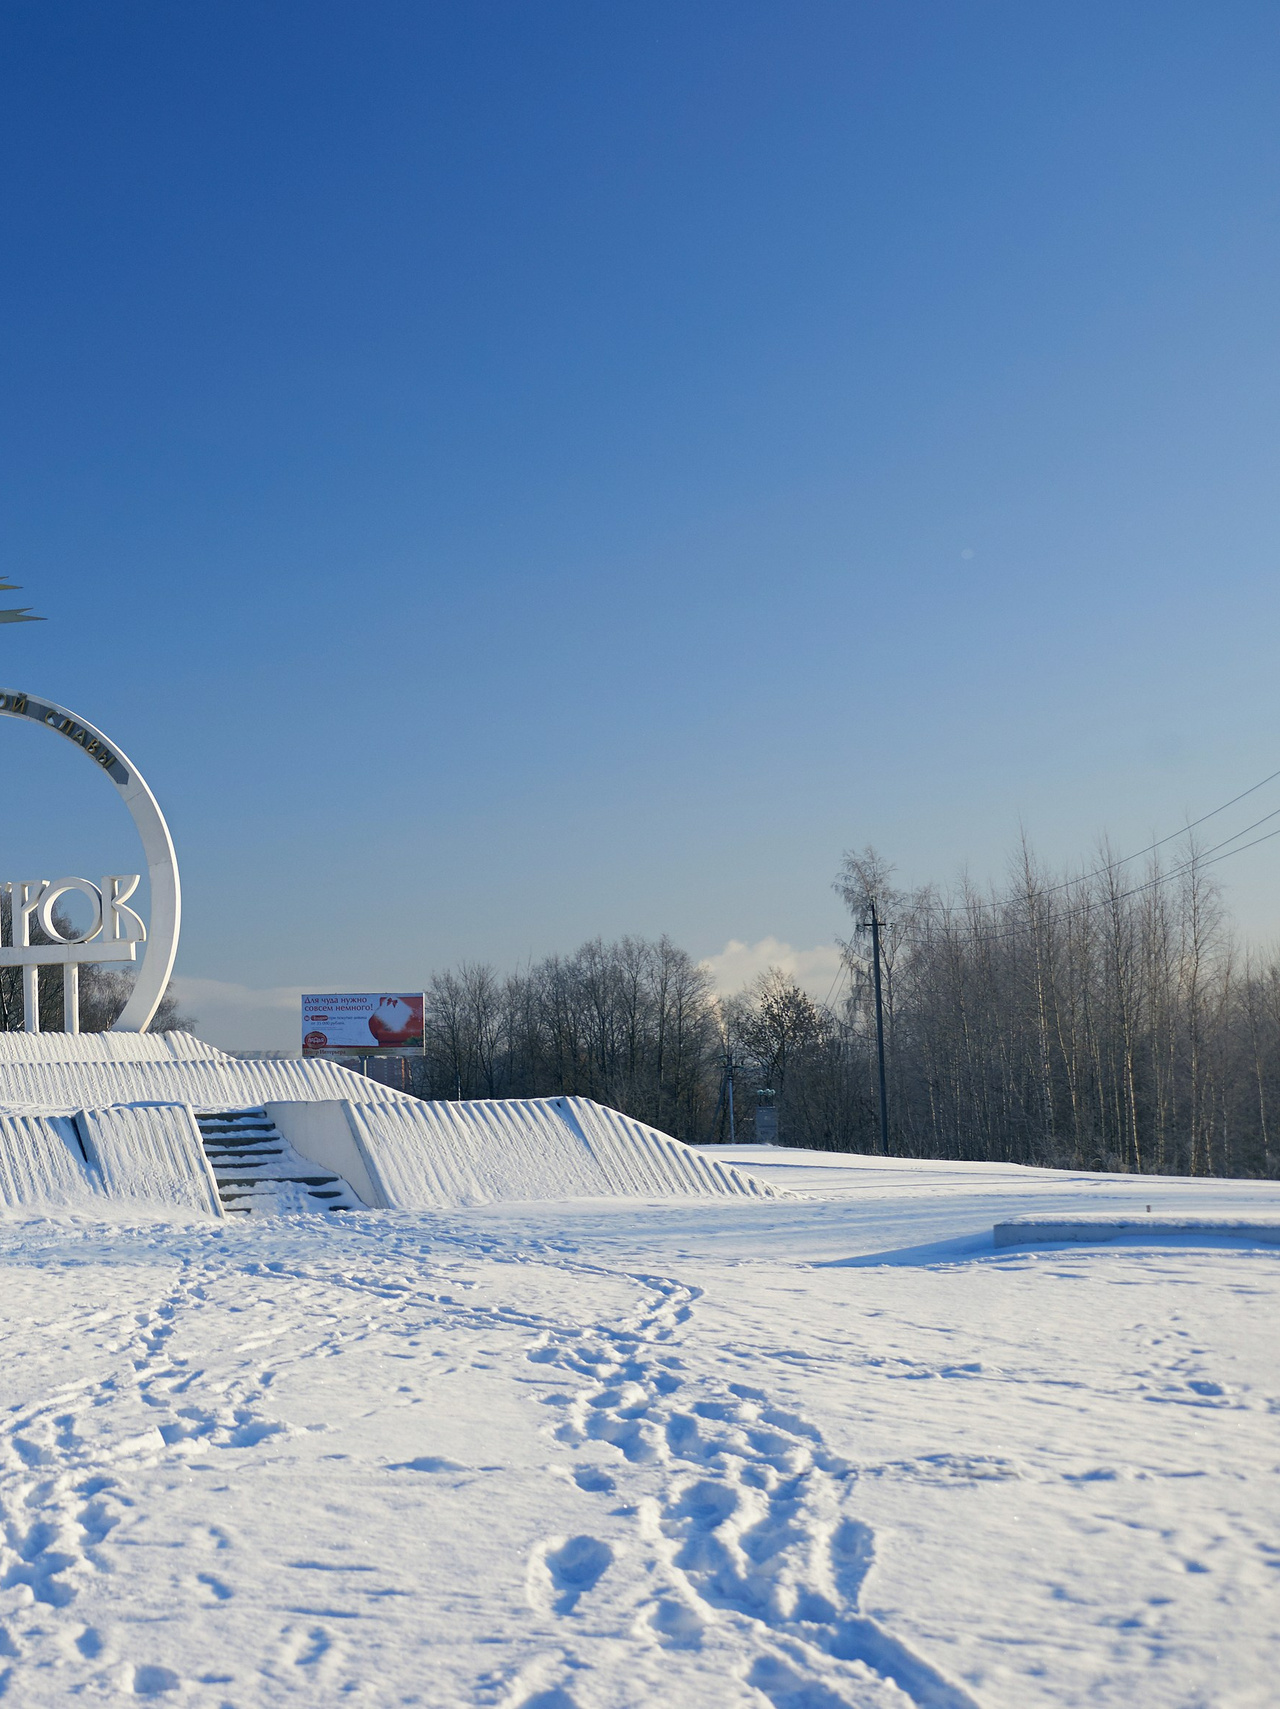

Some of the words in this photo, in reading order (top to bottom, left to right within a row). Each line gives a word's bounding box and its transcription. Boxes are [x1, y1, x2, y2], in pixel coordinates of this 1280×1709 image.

[45, 710, 117, 769] СЛАВЫ
[321, 997, 339, 1005] чуда
[340, 997, 368, 1005] нужно
[335, 1003, 373, 1012] немного!
